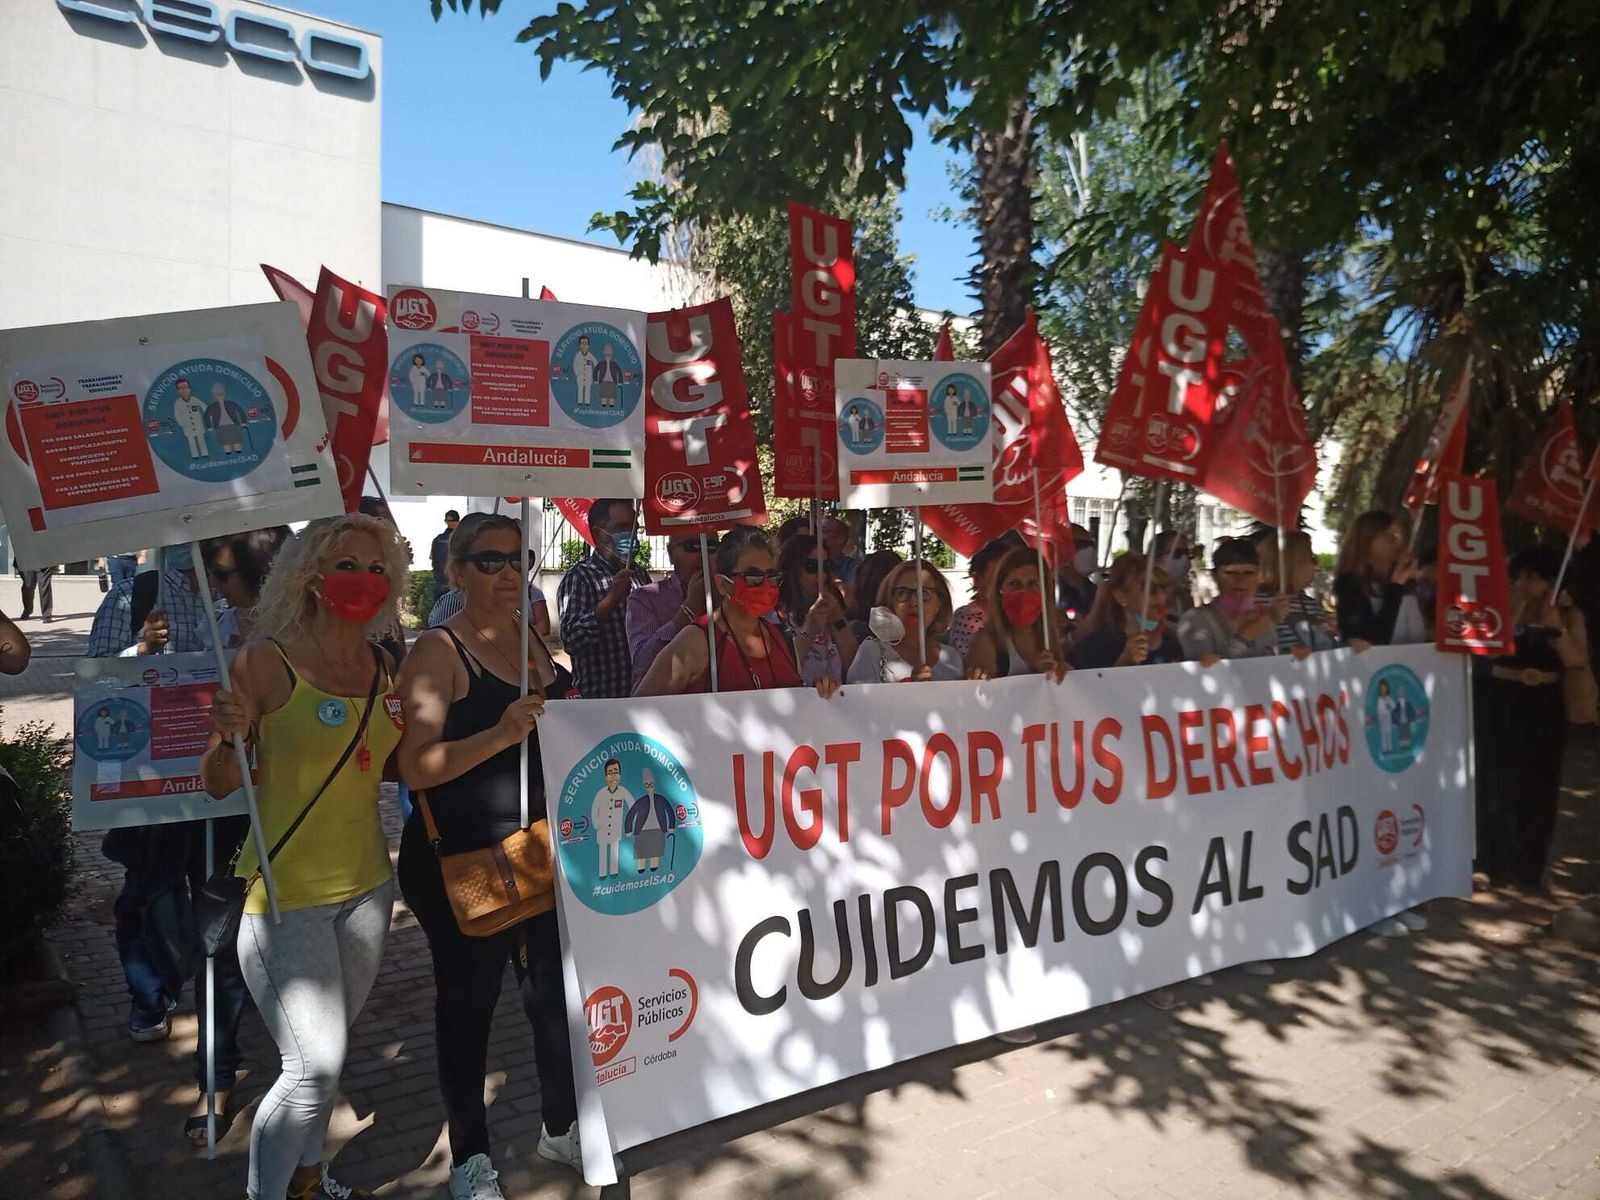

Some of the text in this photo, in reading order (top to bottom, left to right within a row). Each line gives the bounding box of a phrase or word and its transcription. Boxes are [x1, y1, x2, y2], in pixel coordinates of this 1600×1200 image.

[396, 298, 430, 315] UGT
[801, 216, 842, 367] UGT
[1157, 258, 1216, 415] UGT
[149, 364, 261, 411] SERVICIO AYUDA DOMICILIO
[647, 313, 728, 466] UGT
[483, 448, 567, 466] Andalucía
[662, 479, 693, 496] UGT
[893, 470, 943, 482] Andalucía
[1447, 482, 1490, 602] UGT
[564, 740, 688, 805] SERVICIO AYUDA DOMICILIO
[732, 690, 1349, 860] UGT POR TUS DERECHOS
[592, 874, 675, 897] #cuidemoselSAD
[734, 805, 1359, 1016] CUIDEMOS AL SAD
[638, 989, 687, 1011] Servicios
[638, 1006, 683, 1028] Públicos
[644, 1049, 677, 1066] Córdoba
